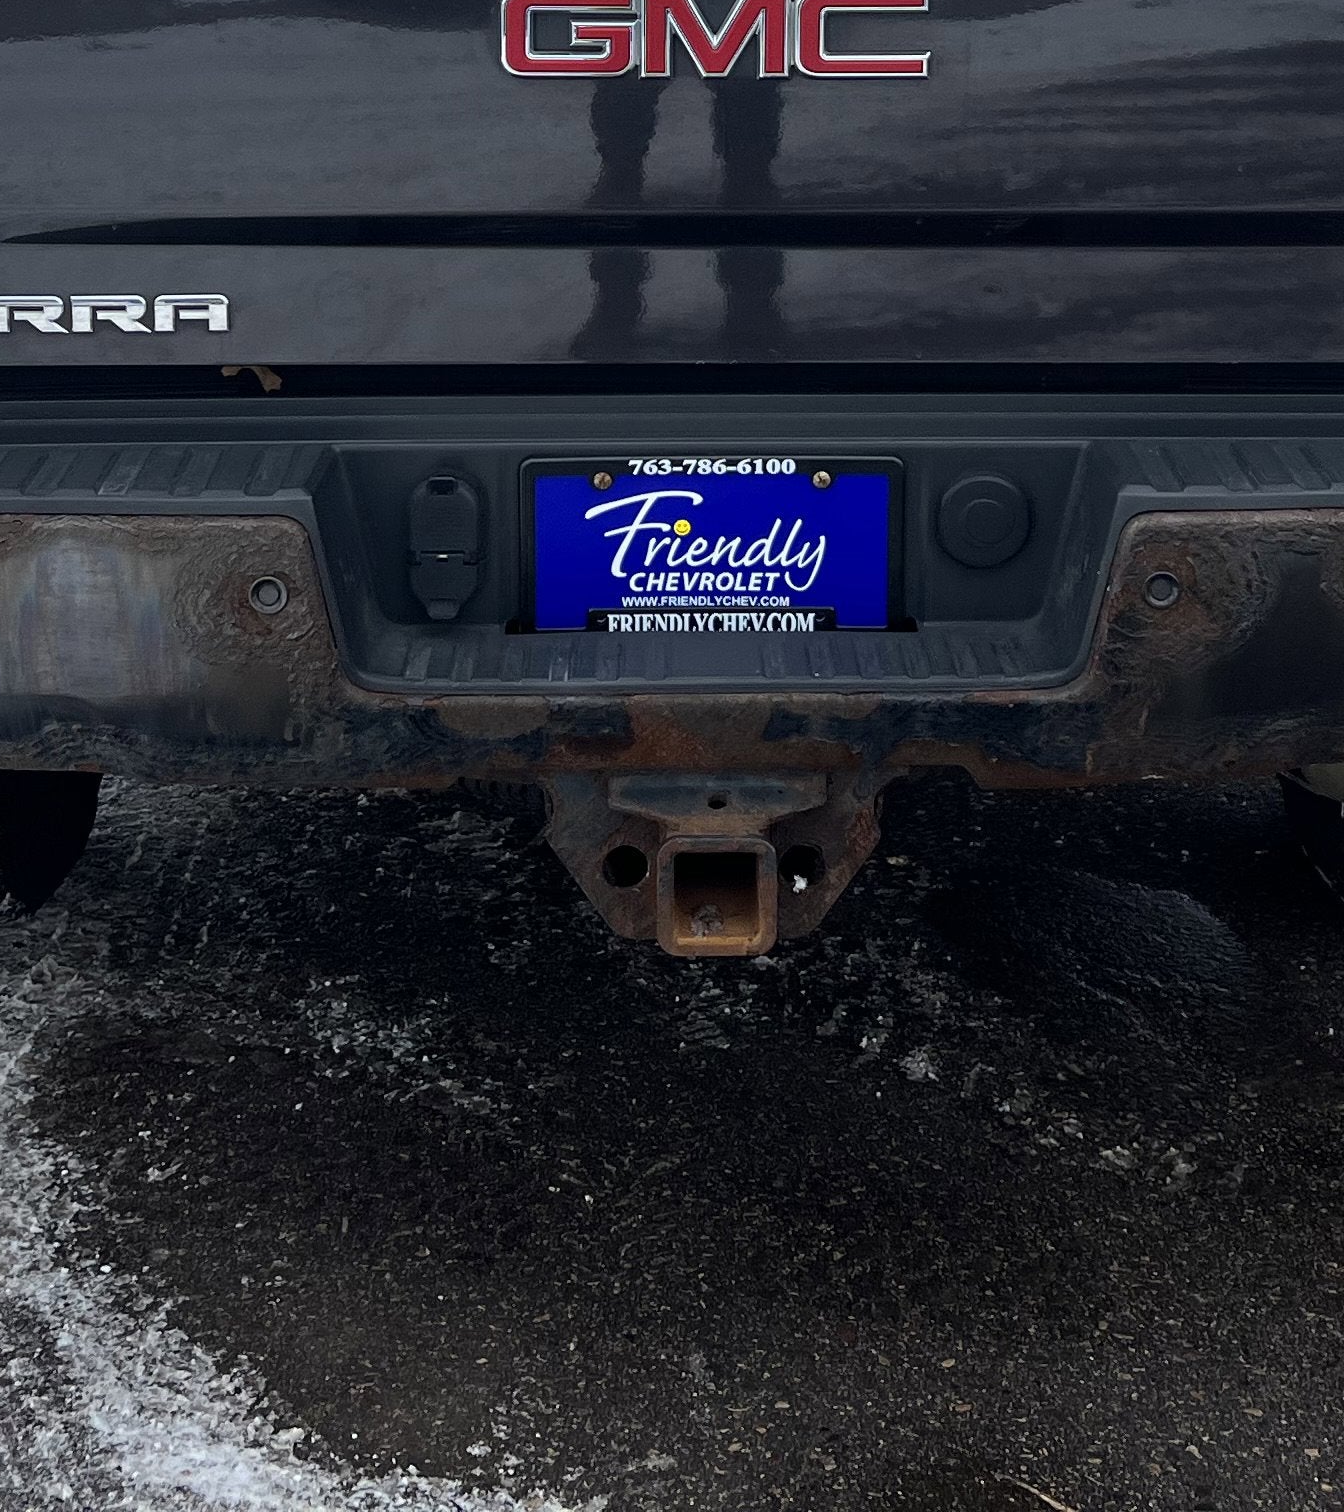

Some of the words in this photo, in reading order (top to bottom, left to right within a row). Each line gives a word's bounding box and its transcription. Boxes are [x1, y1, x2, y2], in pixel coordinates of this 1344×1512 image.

[627, 458, 797, 476] 763-786-6100
[584, 490, 826, 592] Friendly
[629, 571, 781, 592] CHEVROLET
[621, 595, 791, 608] WWW.FRIENDLYCHEV.COM
